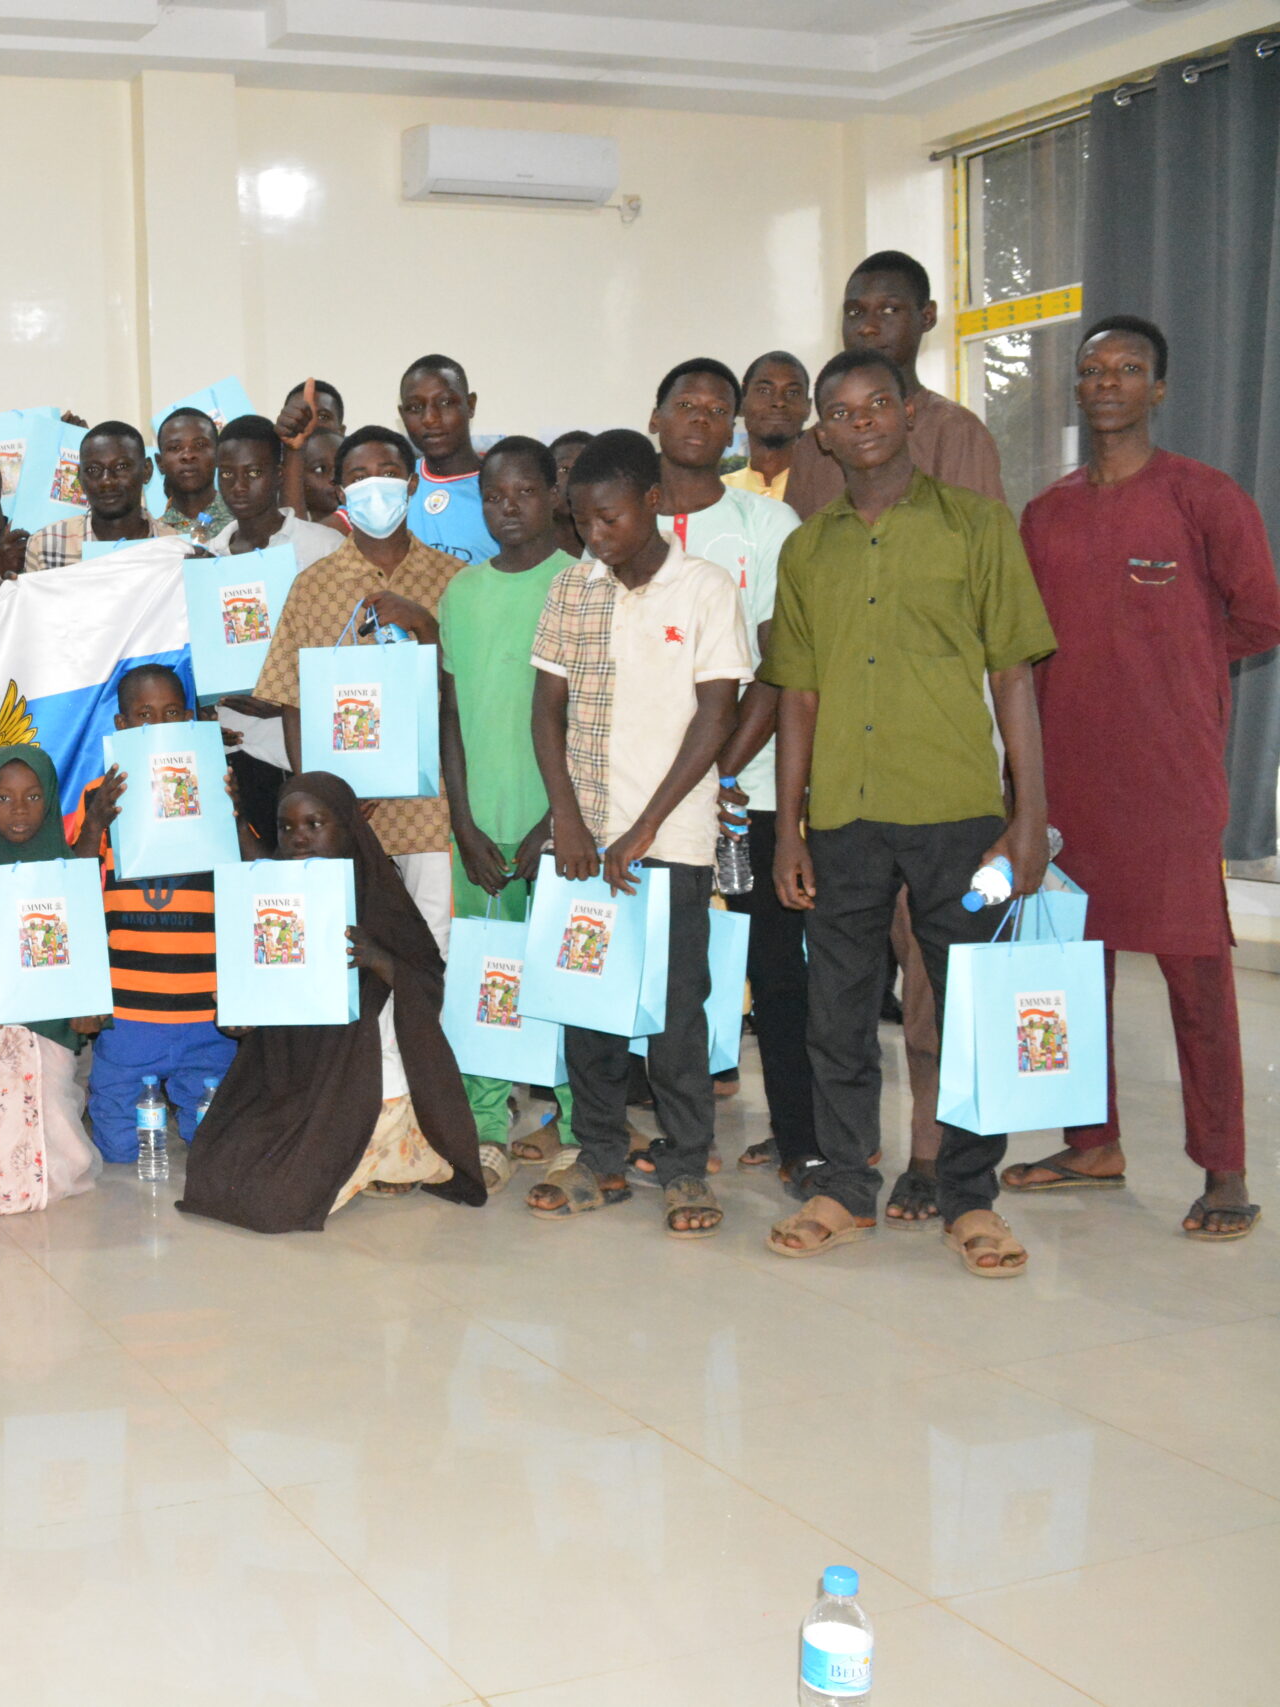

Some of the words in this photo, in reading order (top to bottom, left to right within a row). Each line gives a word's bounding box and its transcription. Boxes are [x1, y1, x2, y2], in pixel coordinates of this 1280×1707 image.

[224, 588, 253, 598] EMMNR
[338, 689, 368, 697] EMMNR
[154, 756, 184, 765] EMMNR
[22, 902, 52, 911] EMMNR
[258, 898, 290, 907] EMMNR
[574, 905, 604, 916] EMMNR
[486, 961, 516, 972] EMMNR
[1020, 997, 1051, 1007] EMMNR
